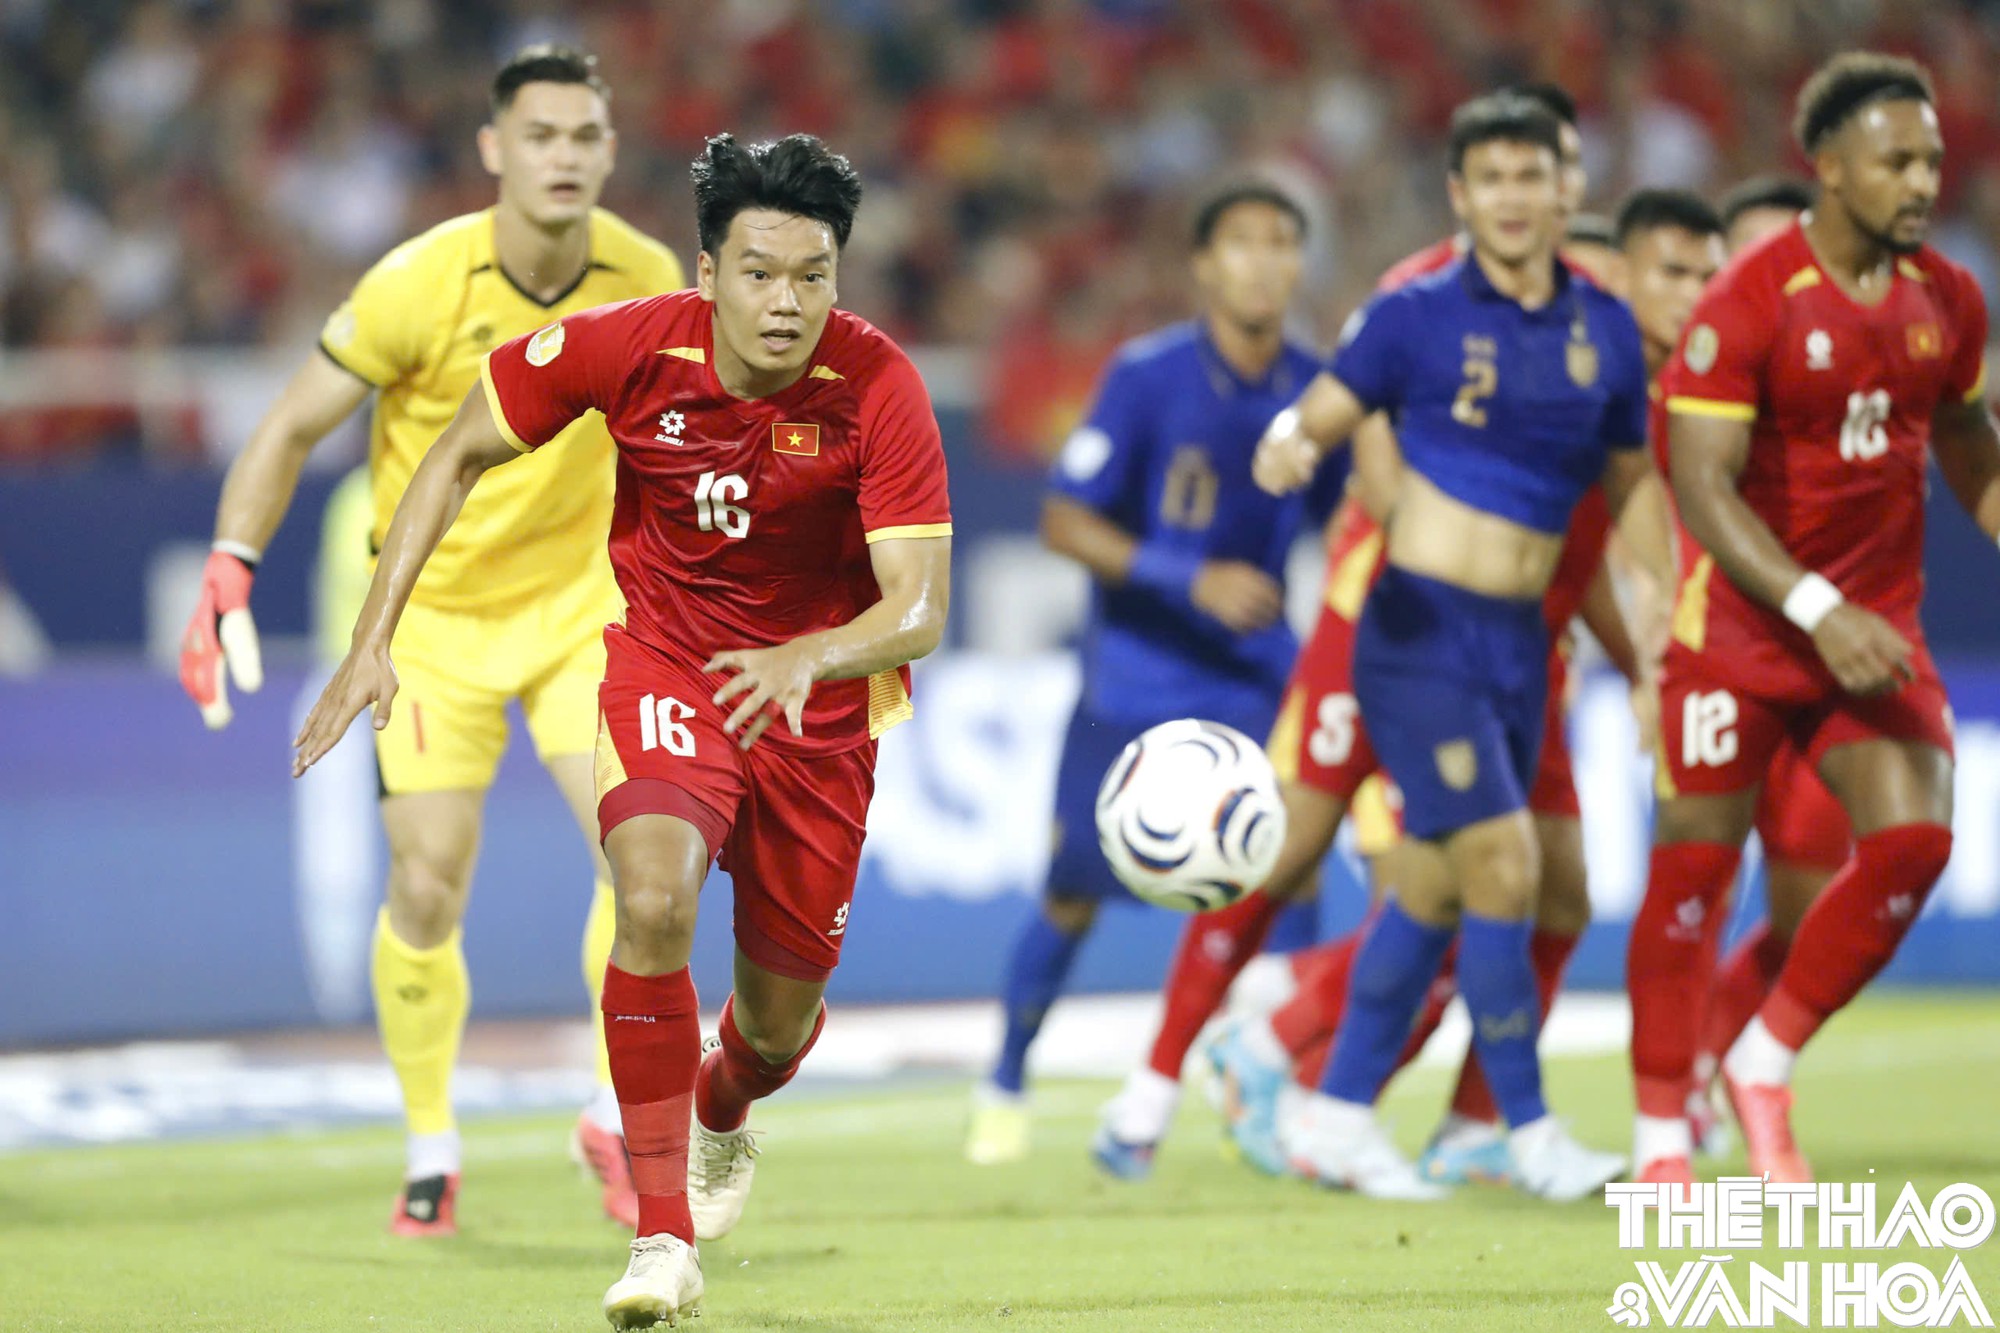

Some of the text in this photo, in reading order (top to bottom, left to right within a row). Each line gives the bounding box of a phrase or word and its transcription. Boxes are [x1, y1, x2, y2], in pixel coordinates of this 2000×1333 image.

[1451, 358, 1498, 428] 2
[694, 471, 750, 539] 16
[411, 700, 426, 754] 1
[639, 693, 696, 757] 16
[1682, 688, 1739, 767] 12
